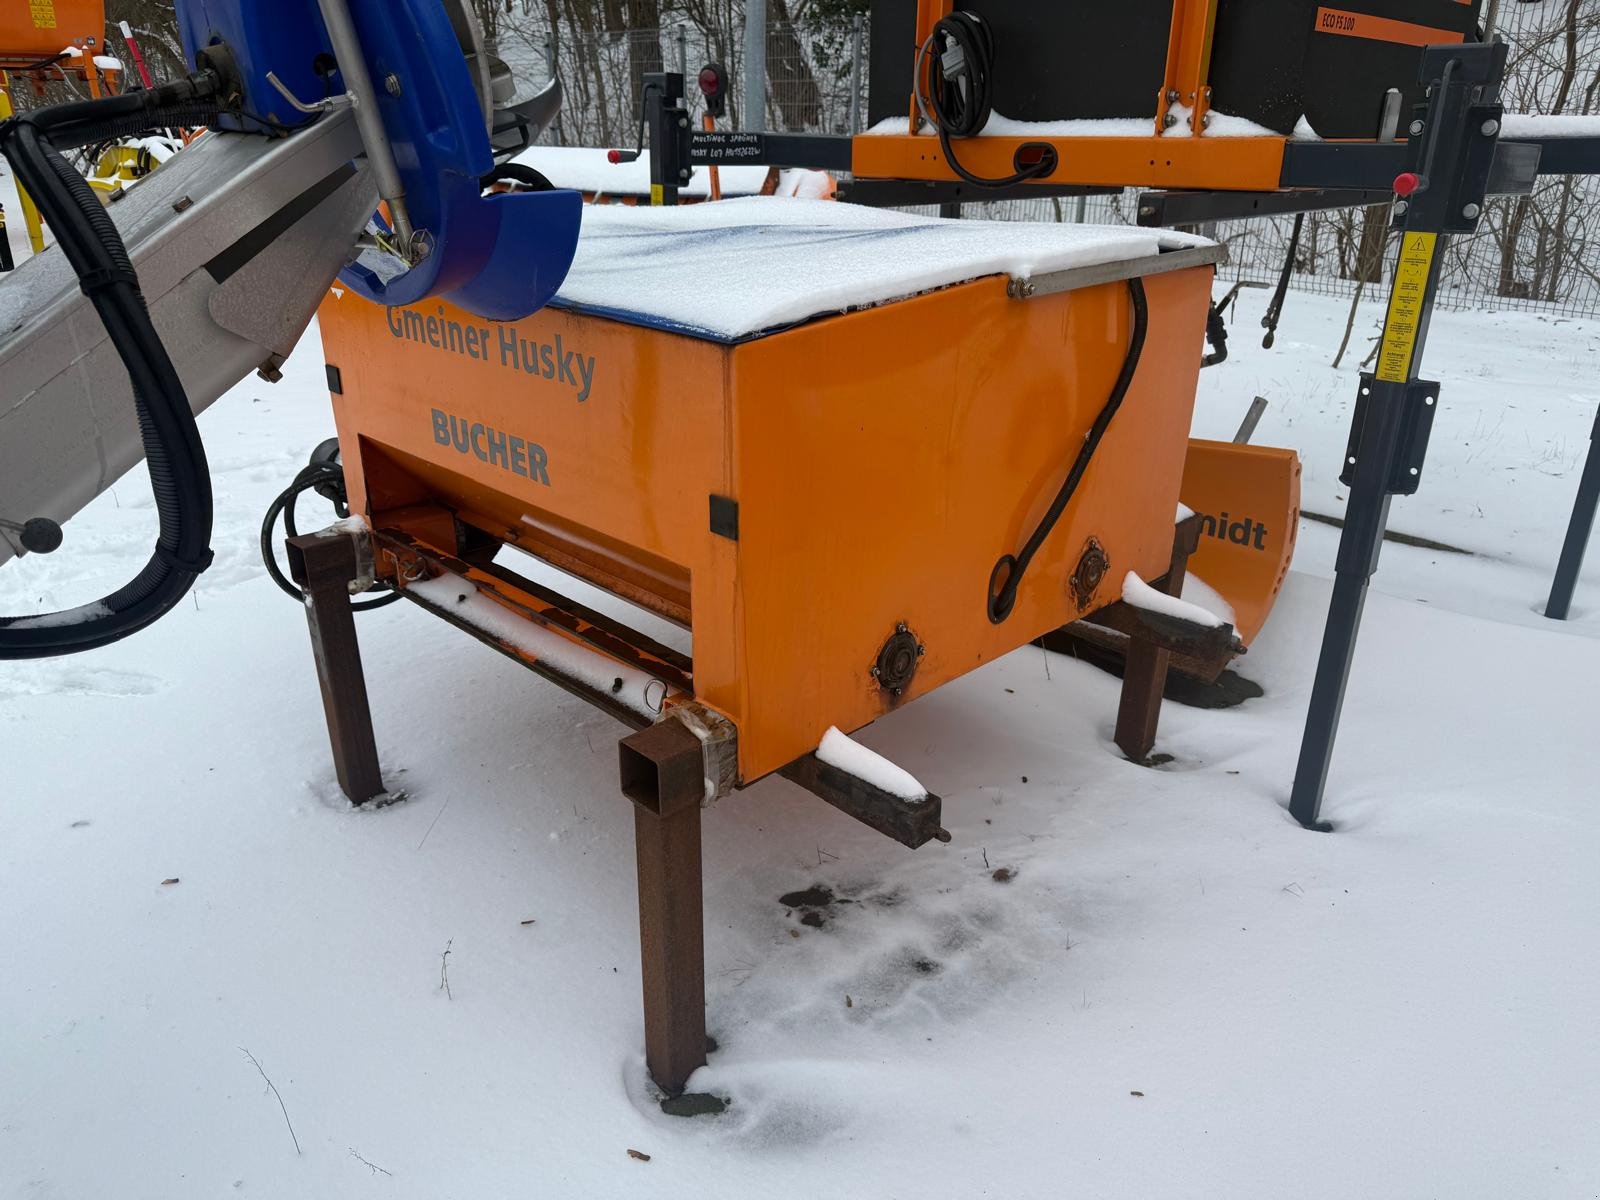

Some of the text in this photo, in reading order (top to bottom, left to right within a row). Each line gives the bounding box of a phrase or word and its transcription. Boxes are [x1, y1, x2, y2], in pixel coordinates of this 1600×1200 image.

[1322, 13, 1335, 27] ECO
[386, 305, 596, 403] Gmeiner Husky
[431, 407, 551, 486] BUCHER
